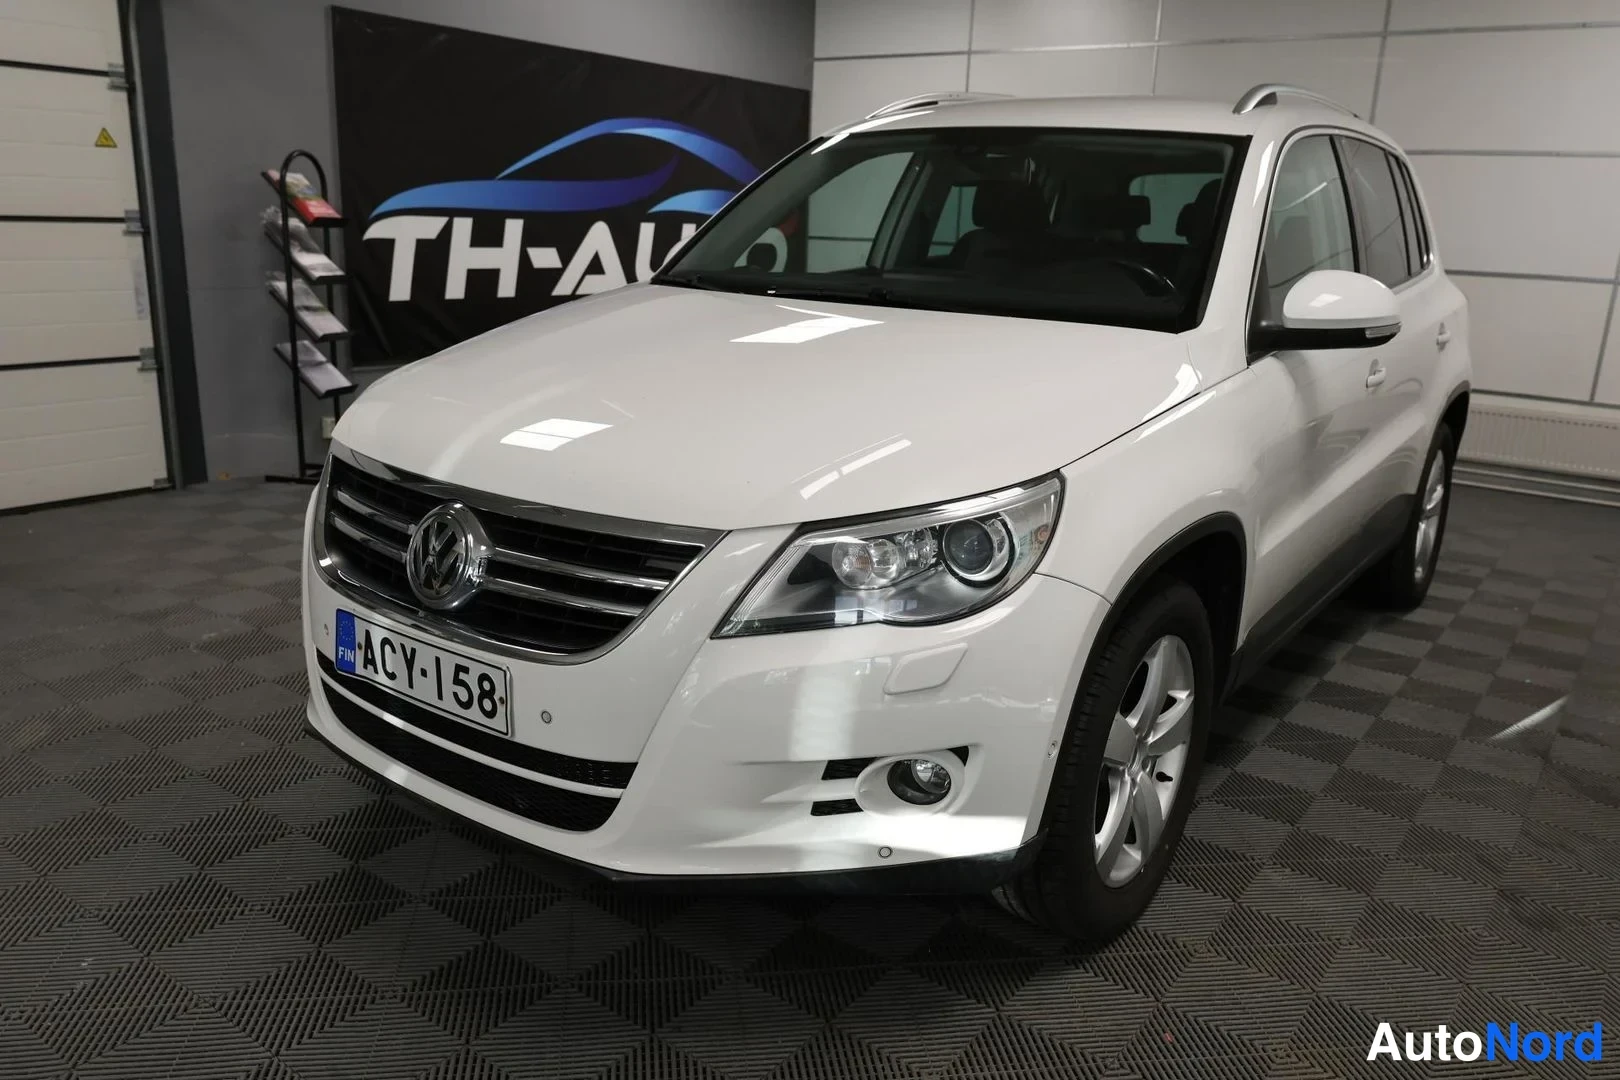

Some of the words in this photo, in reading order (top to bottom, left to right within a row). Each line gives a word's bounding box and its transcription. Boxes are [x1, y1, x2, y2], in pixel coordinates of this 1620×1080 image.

[362, 215, 788, 301] TH-AUO
[338, 646, 355, 664] FIN
[362, 629, 499, 720] ACY-158
